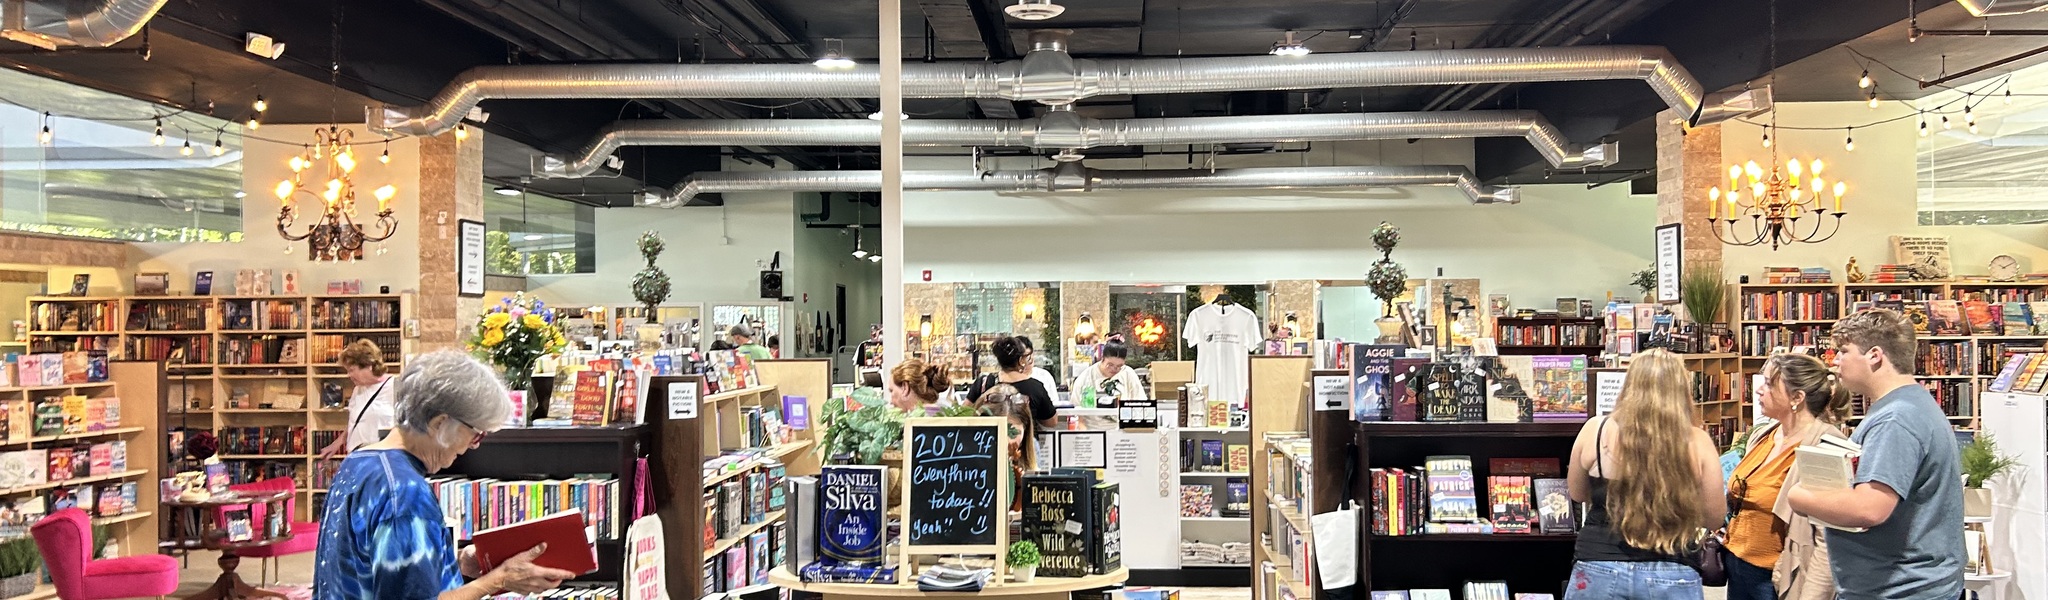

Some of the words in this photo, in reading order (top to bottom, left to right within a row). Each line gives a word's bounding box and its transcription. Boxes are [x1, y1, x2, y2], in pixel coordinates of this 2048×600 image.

[1365, 348, 1394, 357] AGGIE
[1365, 365, 1390, 374] GHOS
[1432, 372, 1454, 382] SPELL
[1434, 390, 1456, 399] WAKE
[1210, 404, 1218, 426] BOOK
[1218, 402, 1227, 422] CLUB
[1433, 405, 1457, 414] DEAD
[914, 429, 963, 458] 20%
[974, 430, 994, 454] off
[1230, 449, 1239, 470] BOOK
[1239, 447, 1248, 467] CLUB
[1430, 460, 1472, 470] BUCKEYE
[827, 473, 878, 486] DANIEL
[913, 463, 987, 496] everything
[1433, 481, 1470, 491] PATRICK
[1031, 486, 1074, 504] Rebecca
[1494, 484, 1527, 494] Sweet
[825, 484, 877, 511] Silva
[1497, 495, 1524, 505] Heat
[928, 490, 975, 521] today
[1442, 502, 1465, 511] RYAN
[844, 513, 860, 524] An
[1041, 504, 1065, 522] Ross
[838, 524, 867, 535] Inside
[843, 535, 860, 546] Job
[1042, 533, 1065, 551] Wild
[1038, 555, 1080, 569] verence
[638, 565, 658, 586] HAPPY
[806, 569, 833, 583] Silva
[640, 583, 658, 600] PLACE
[1466, 582, 1507, 600] AMITY
